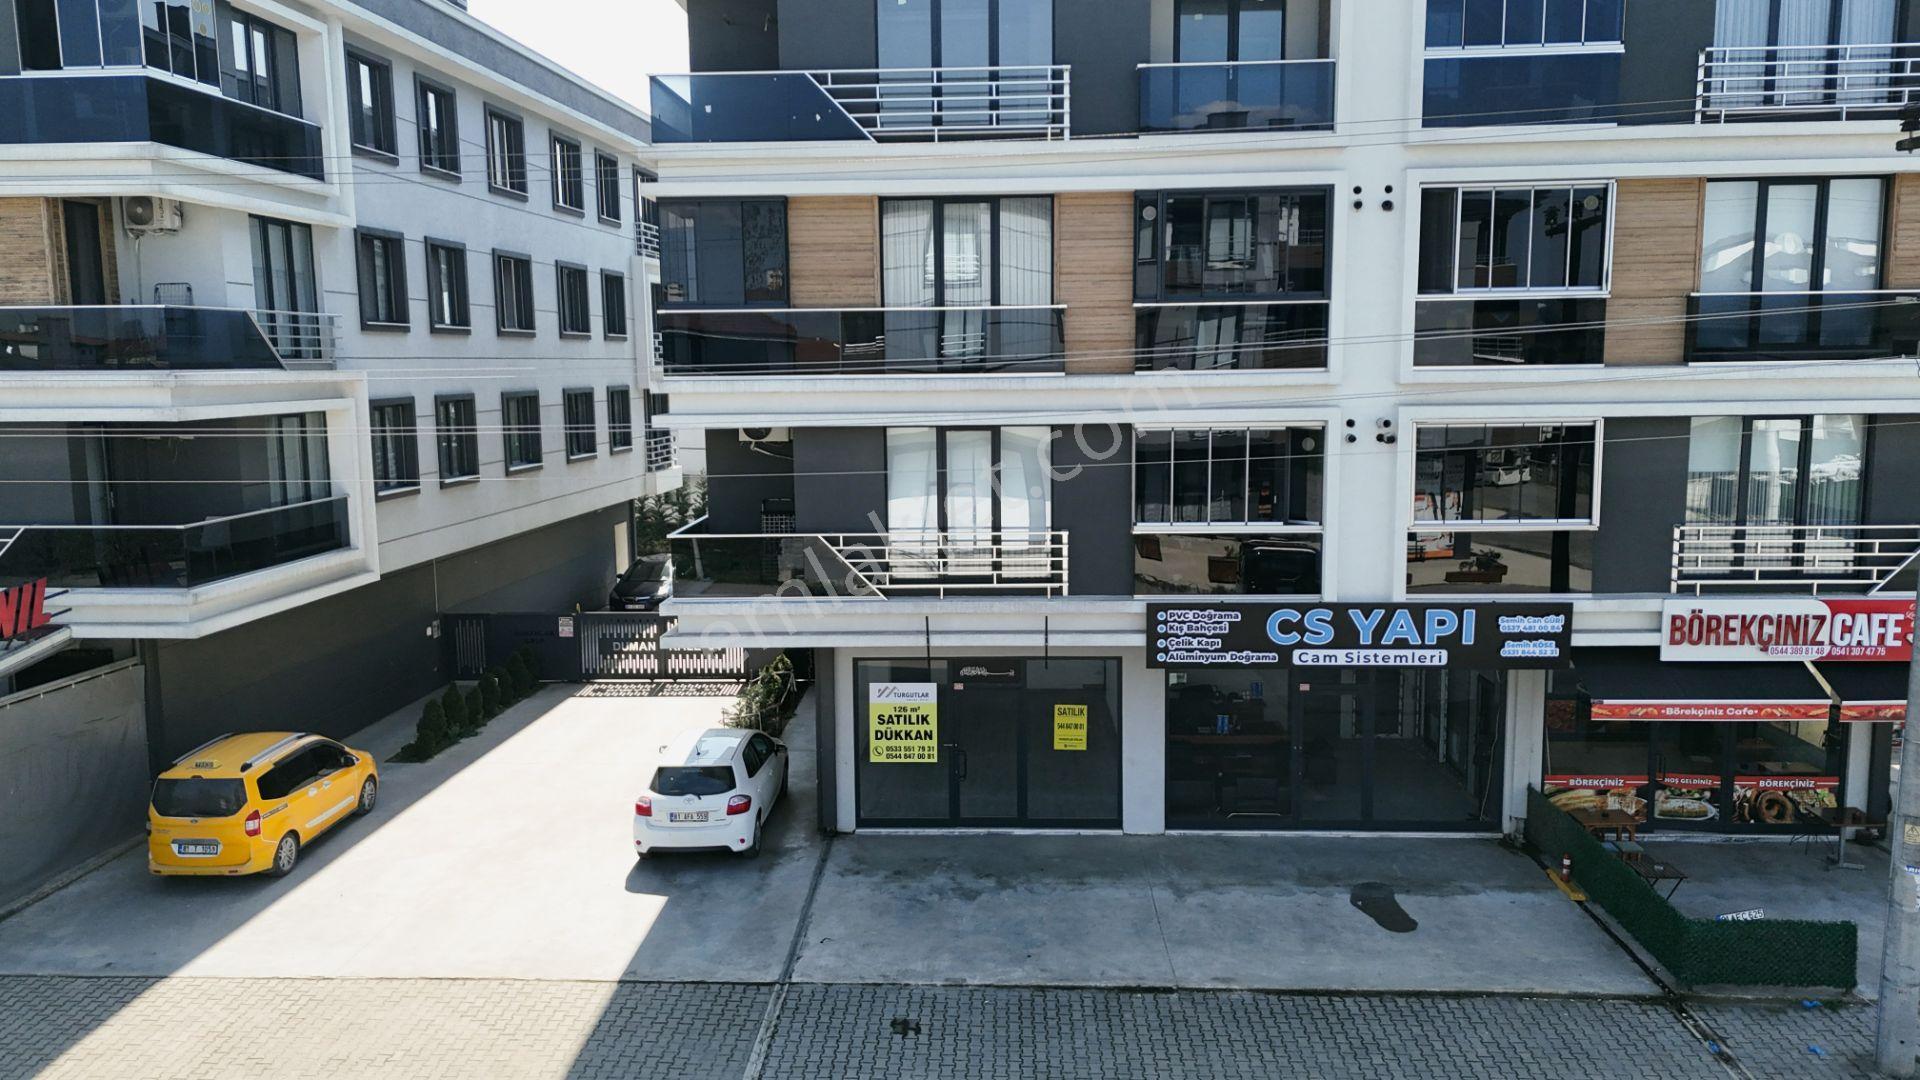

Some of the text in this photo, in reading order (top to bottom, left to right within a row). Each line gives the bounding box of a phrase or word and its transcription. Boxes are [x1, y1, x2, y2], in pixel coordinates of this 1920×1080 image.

[1168, 610, 1240, 621] PVC Doğrama
[1500, 616, 1525, 625] Semih
[1527, 617, 1542, 625] Can
[1168, 623, 1228, 634] Kış Bahçesi
[1266, 608, 1476, 646] CS YAPI
[1669, 608, 1828, 652] BÖREKÇİNİZ
[1831, 613, 1905, 647] CAFE
[613, 641, 656, 651] DUMAN
[1168, 638, 1220, 649] Çelik Kapı
[1506, 640, 1531, 649] Semih
[1770, 647, 1825, 655] 0544 389 81 48
[1831, 647, 1850, 655] 0541
[1866, 647, 1876, 655] 47
[1168, 652, 1278, 663] Alüminyum Doğrama
[1298, 650, 1444, 664] Cam Sistemleri
[1057, 707, 1085, 717] SATILIK
[1665, 707, 1754, 717] Börekçiniz Cafe
[877, 714, 930, 725] SATILIK
[874, 727, 933, 741] DÜKKAN
[1568, 777, 1625, 787] BÖREKÇİNİZ
[1680, 777, 1713, 786] GELDİNİZ
[1759, 778, 1816, 788] BÖREKÇİNİZ
